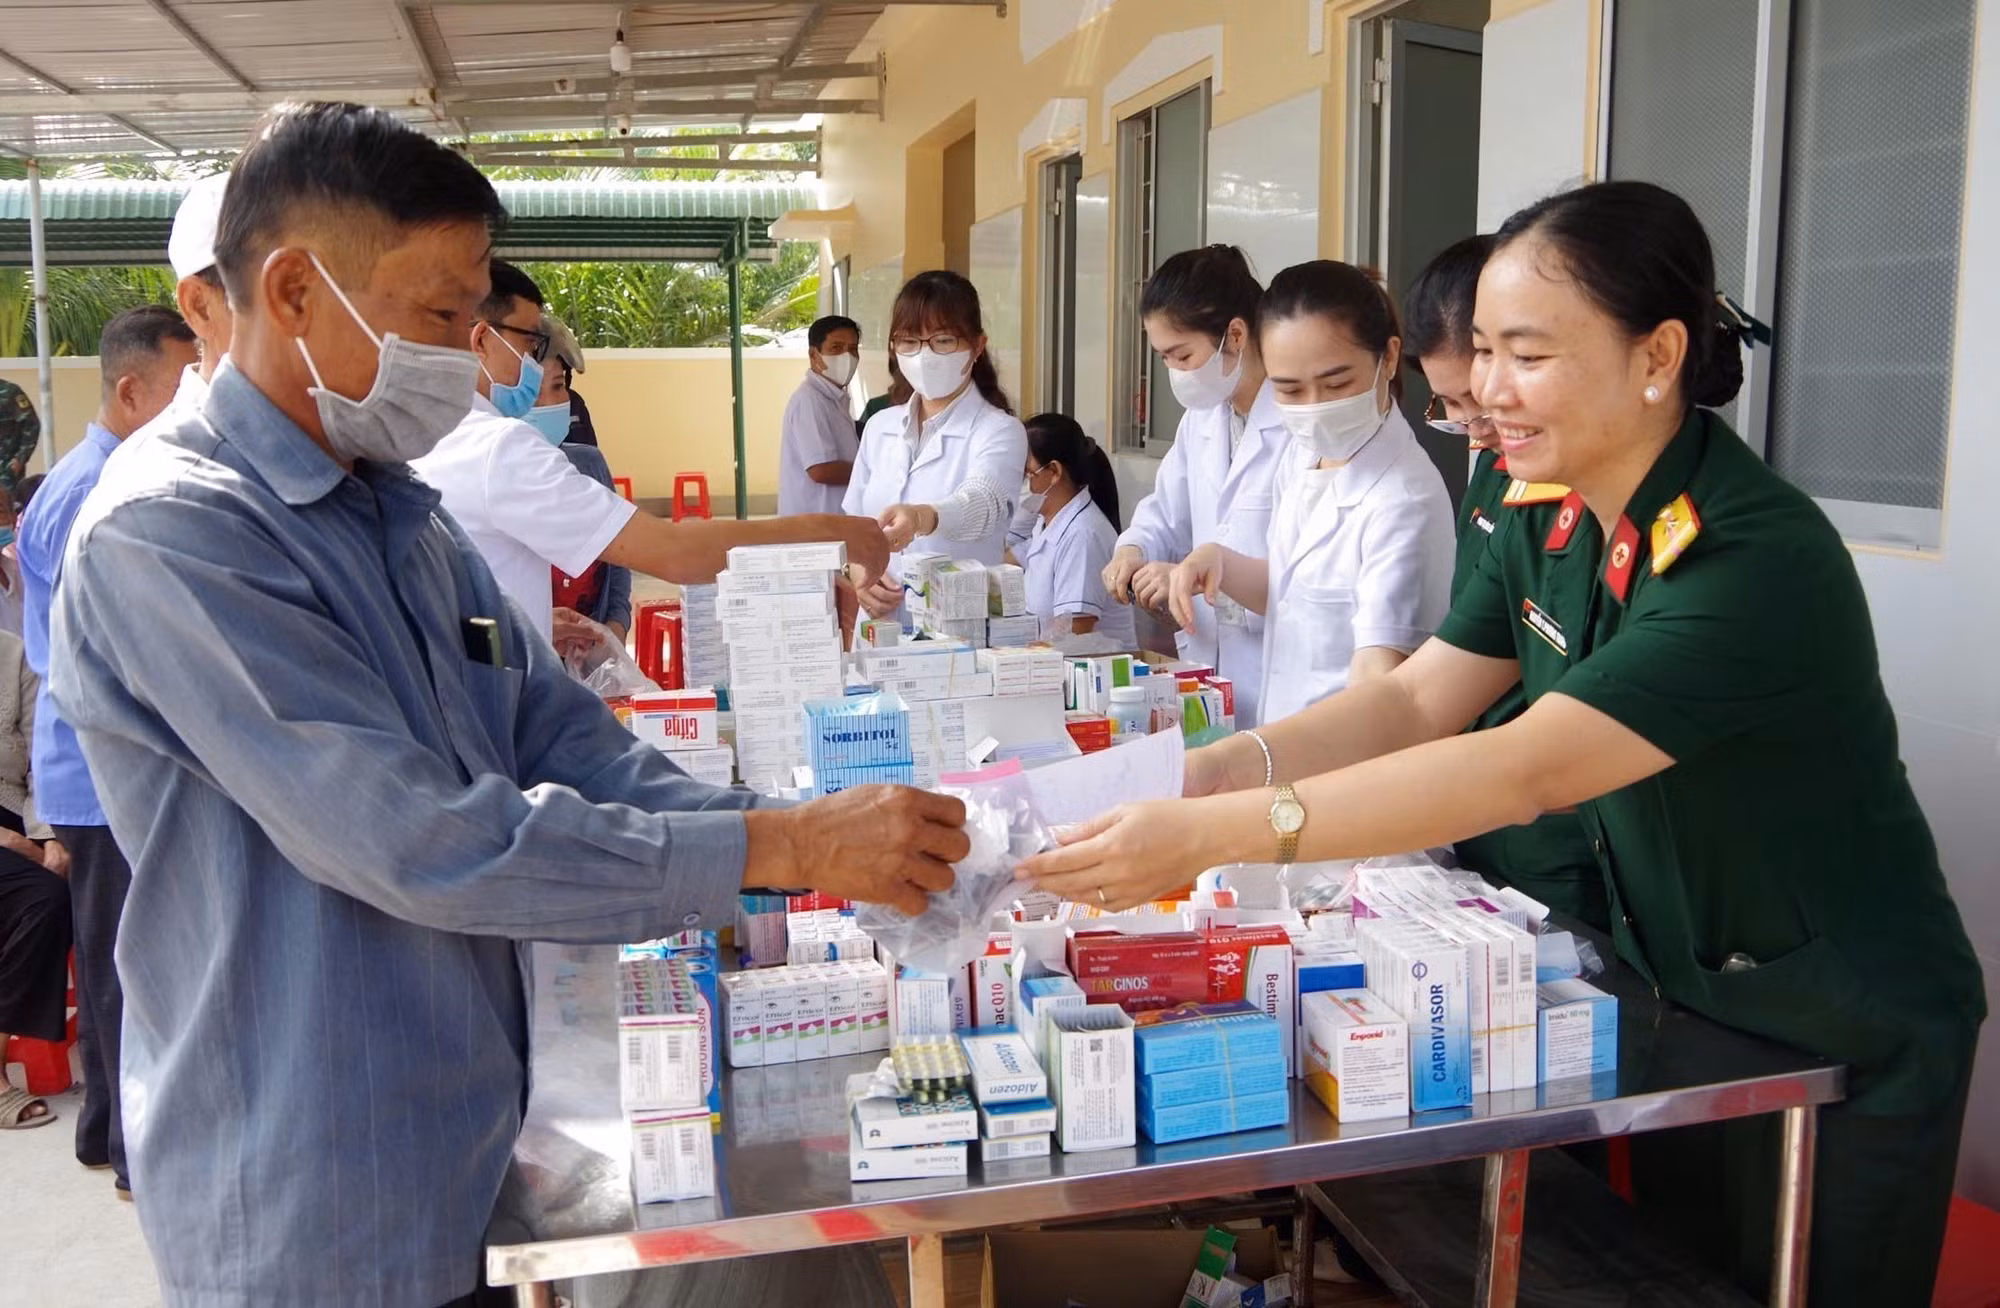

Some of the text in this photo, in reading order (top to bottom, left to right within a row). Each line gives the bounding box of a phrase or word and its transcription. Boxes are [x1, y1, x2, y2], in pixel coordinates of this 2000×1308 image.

[664, 715, 698, 740] Cifga
[822, 729, 899, 744] SORBITOL
[991, 983, 1005, 1005] Q10
[1091, 975, 1149, 992] TARGINOS
[1430, 984, 1447, 1082] CARDIVASOR
[992, 1043, 1022, 1075] Aldozen
[988, 1082, 1038, 1095] Aldozen
